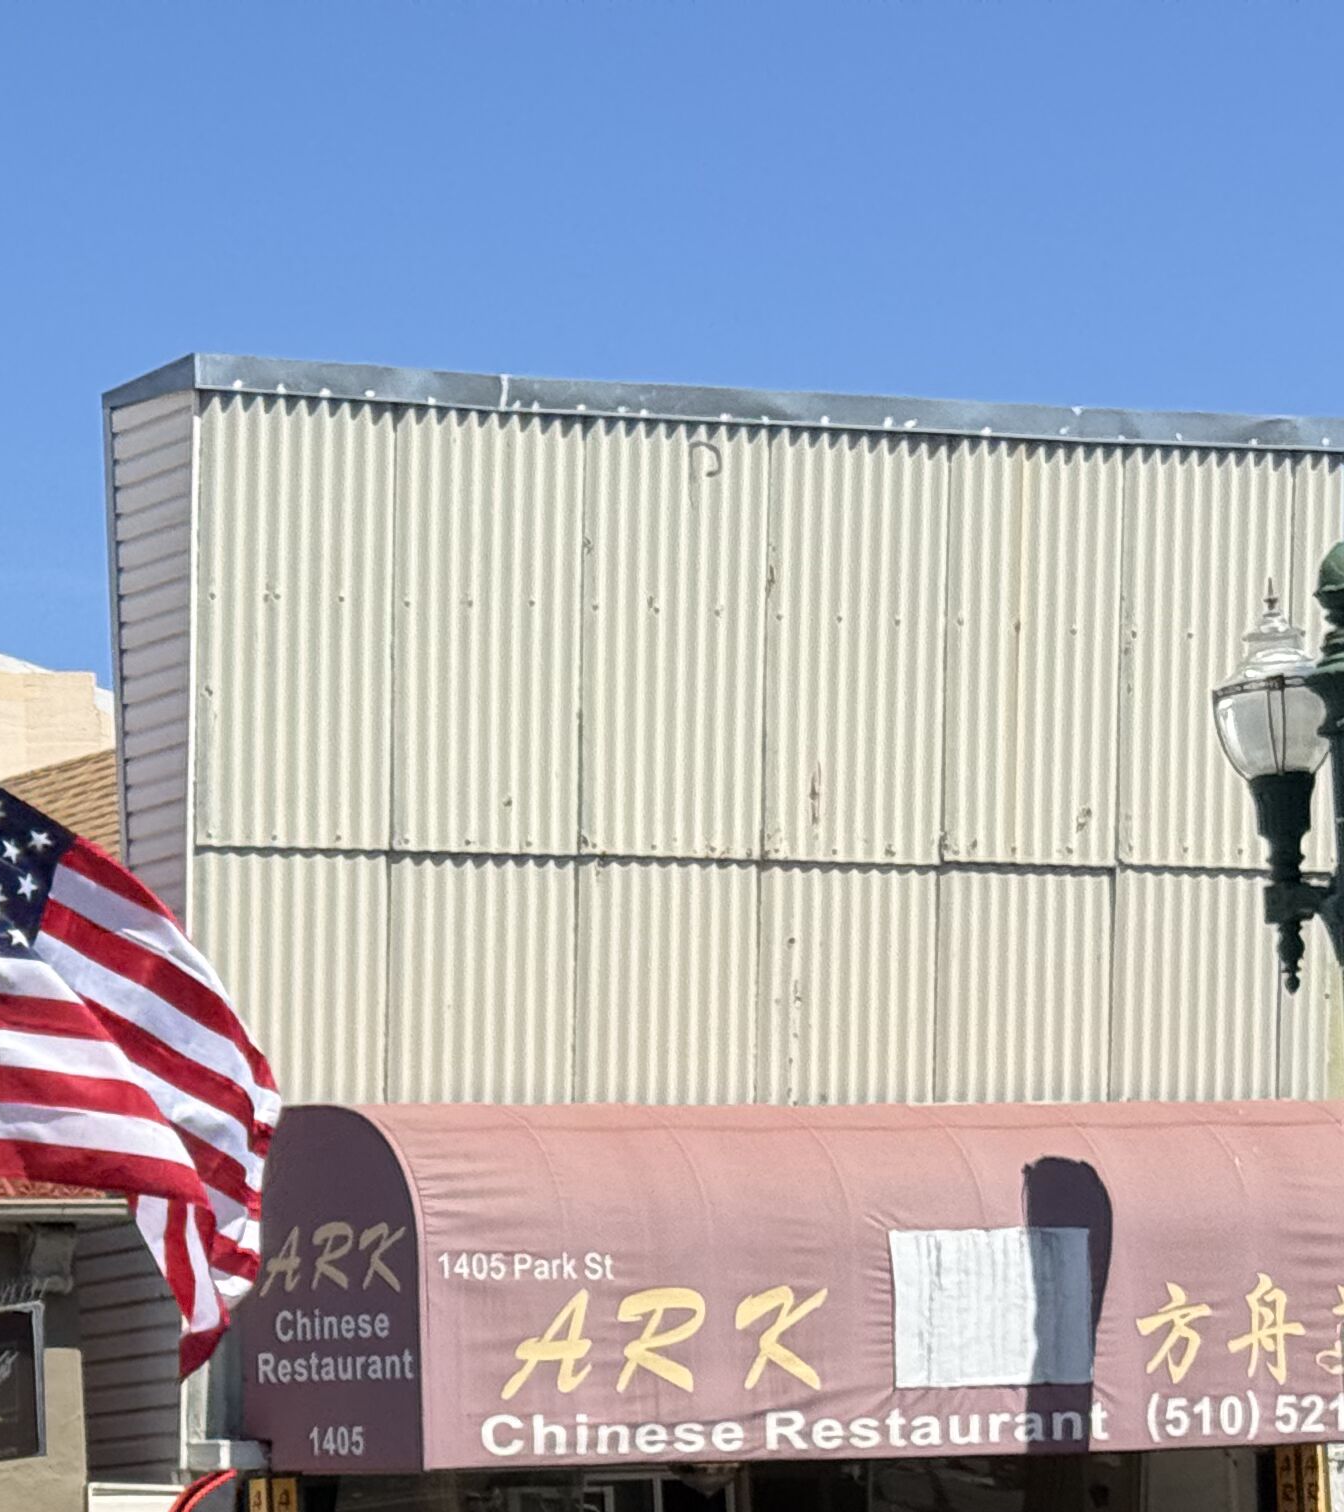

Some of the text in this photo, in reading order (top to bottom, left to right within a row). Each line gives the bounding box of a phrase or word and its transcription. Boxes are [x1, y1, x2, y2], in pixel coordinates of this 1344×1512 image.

[261, 1221, 407, 1299] ARK
[438, 1251, 614, 1281] 1405 Park St
[275, 1310, 391, 1342] Chinese
[501, 1285, 829, 1401] ARK
[1136, 1272, 1344, 1386] 方舟
[258, 1347, 414, 1384] Restaurant
[308, 1426, 366, 1457] 1405
[481, 1412, 744, 1456] Chinese
[765, 1406, 1109, 1451] Restaurant
[1147, 1392, 1260, 1440] (510)
